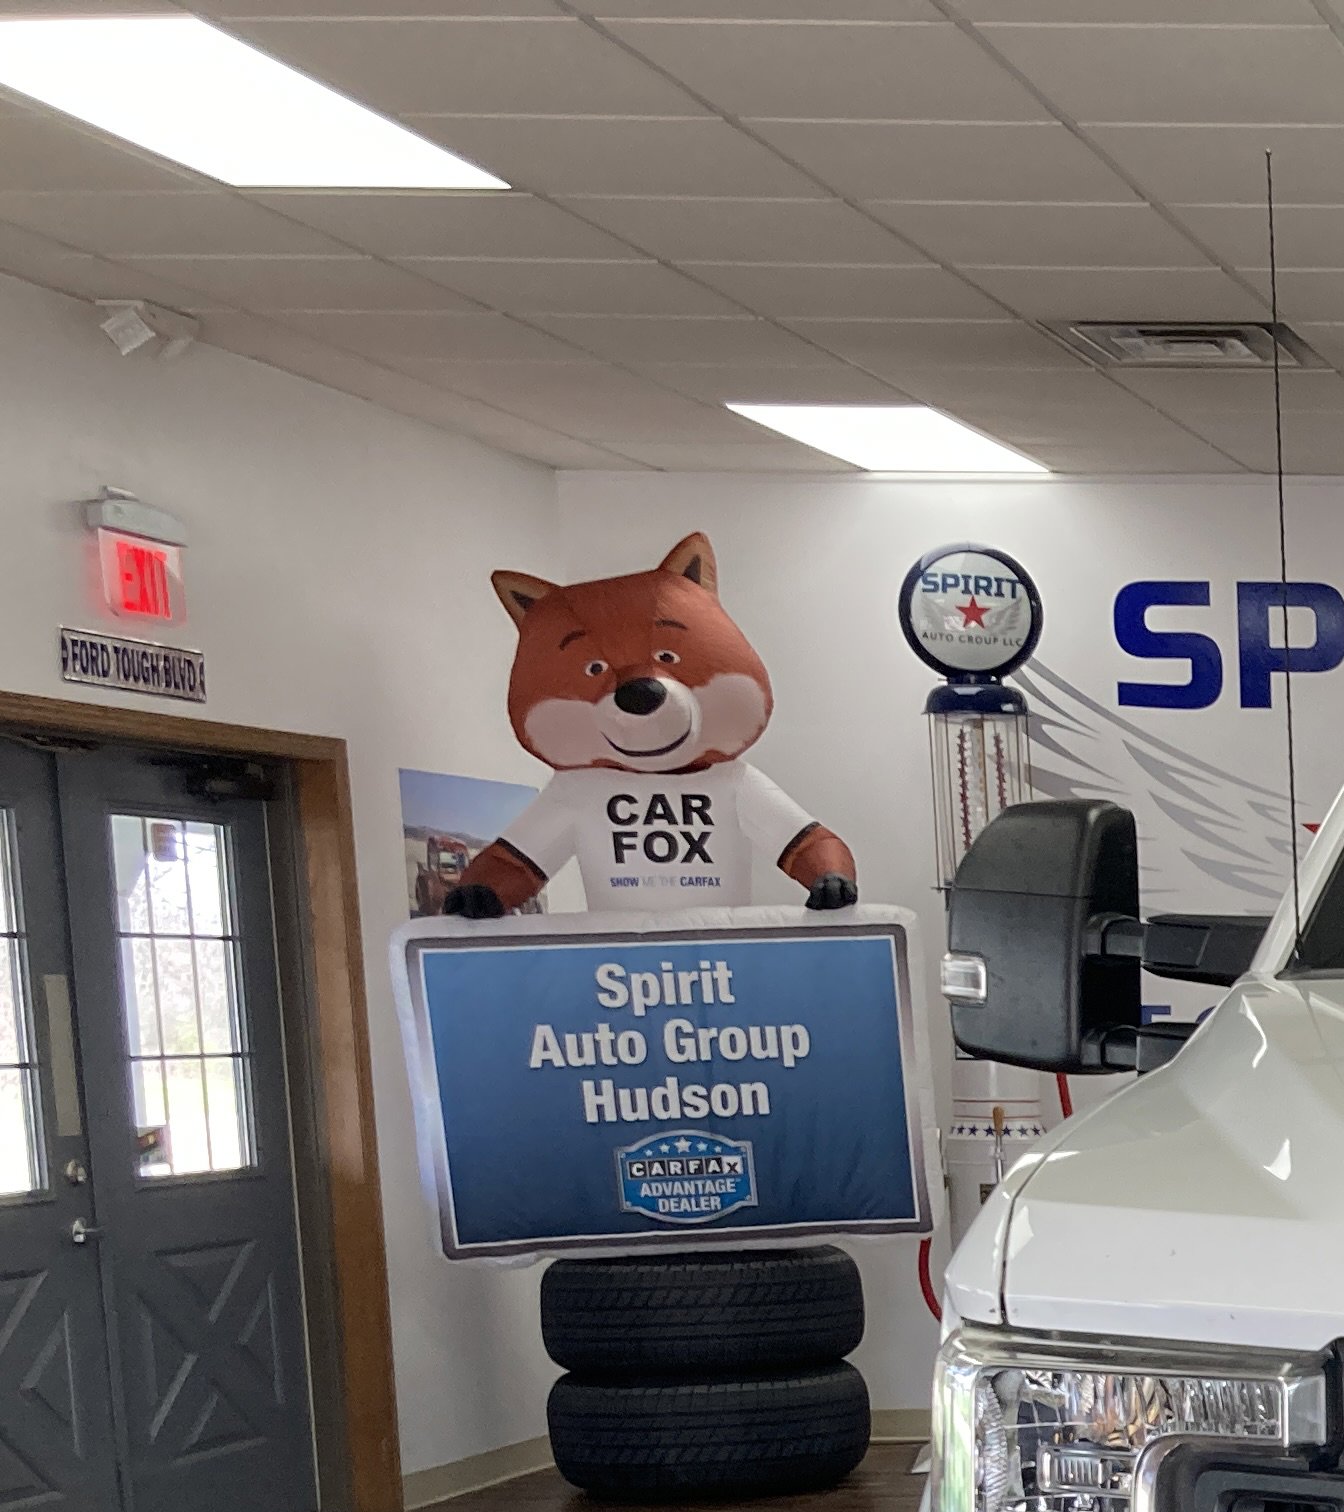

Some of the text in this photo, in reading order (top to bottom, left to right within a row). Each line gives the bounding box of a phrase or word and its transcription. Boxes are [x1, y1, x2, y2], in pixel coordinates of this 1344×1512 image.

[116, 541, 171, 619] EXIT
[921, 573, 1020, 599] SPIRIT
[922, 631, 1022, 647] AUTO GROUP LLC
[71, 638, 197, 692] FORD TOUGH BLVD
[606, 794, 715, 826] CAR
[612, 830, 714, 864] FOX
[610, 877, 639, 888] SHOW
[679, 876, 721, 888] CARFAX
[595, 960, 736, 1016] Spirit
[529, 1018, 811, 1068] Auto Group
[582, 1076, 771, 1123] Hudson
[630, 1158, 739, 1177] CARFAX
[640, 1178, 737, 1197] ADVANTAGE
[658, 1195, 722, 1213] DEALER
